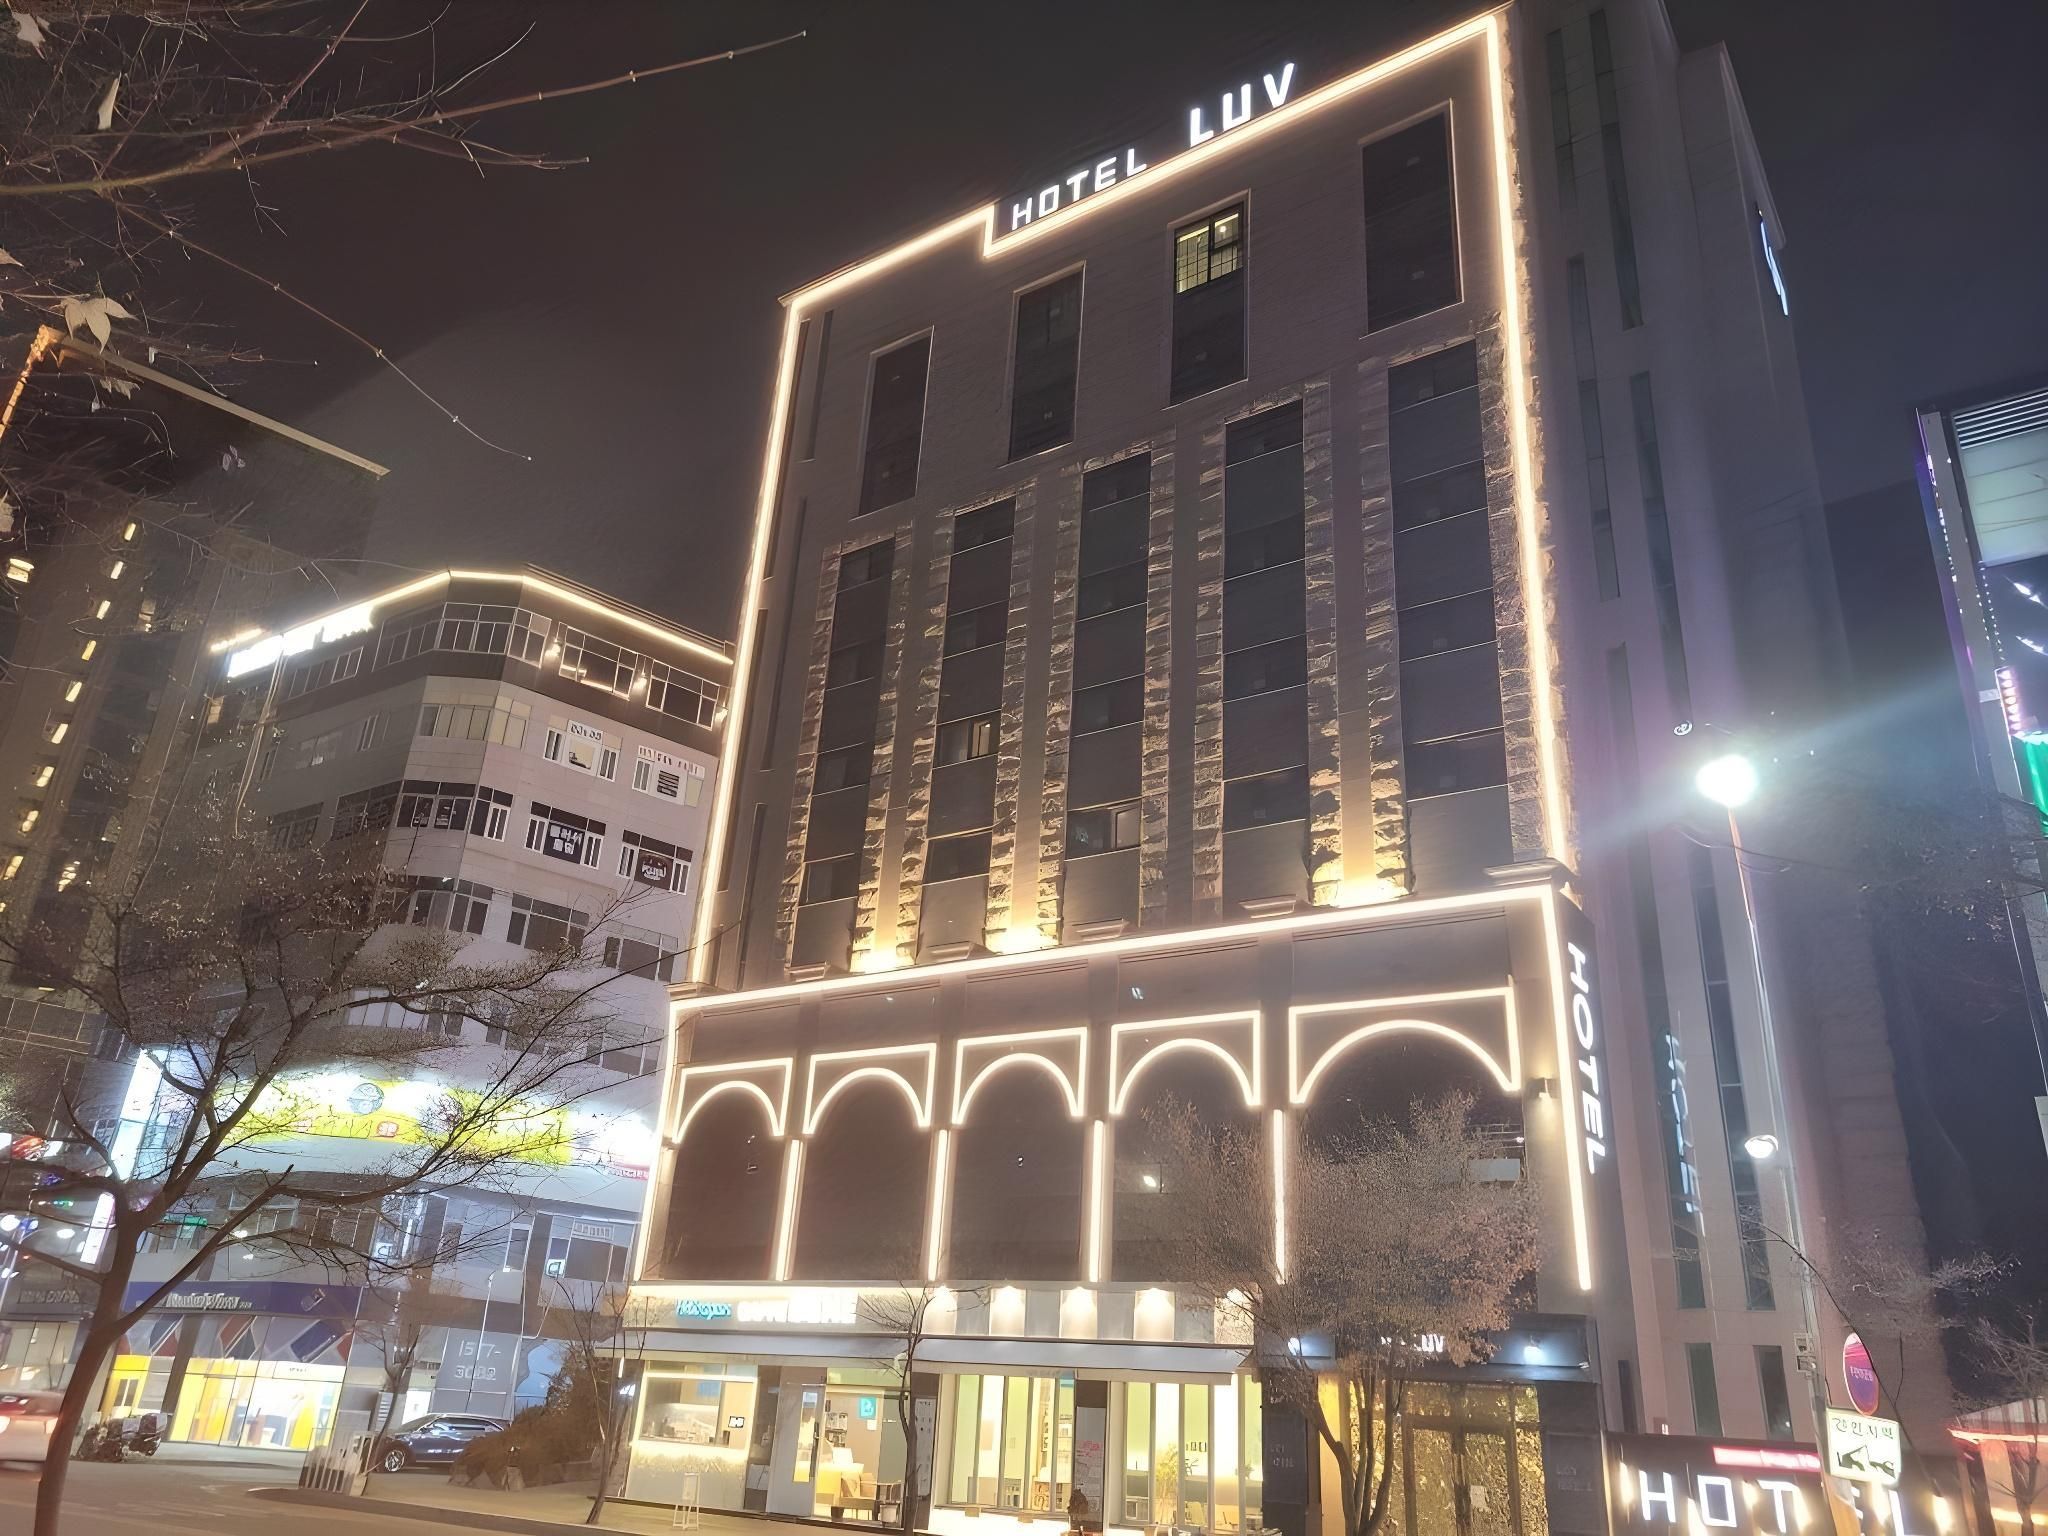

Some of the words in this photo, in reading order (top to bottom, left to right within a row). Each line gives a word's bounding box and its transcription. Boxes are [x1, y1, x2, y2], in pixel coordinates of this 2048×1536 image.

[1011, 148, 1148, 231] HOTEL
[1189, 62, 1297, 148] LUV
[1566, 942, 1608, 1175] HOTEL
